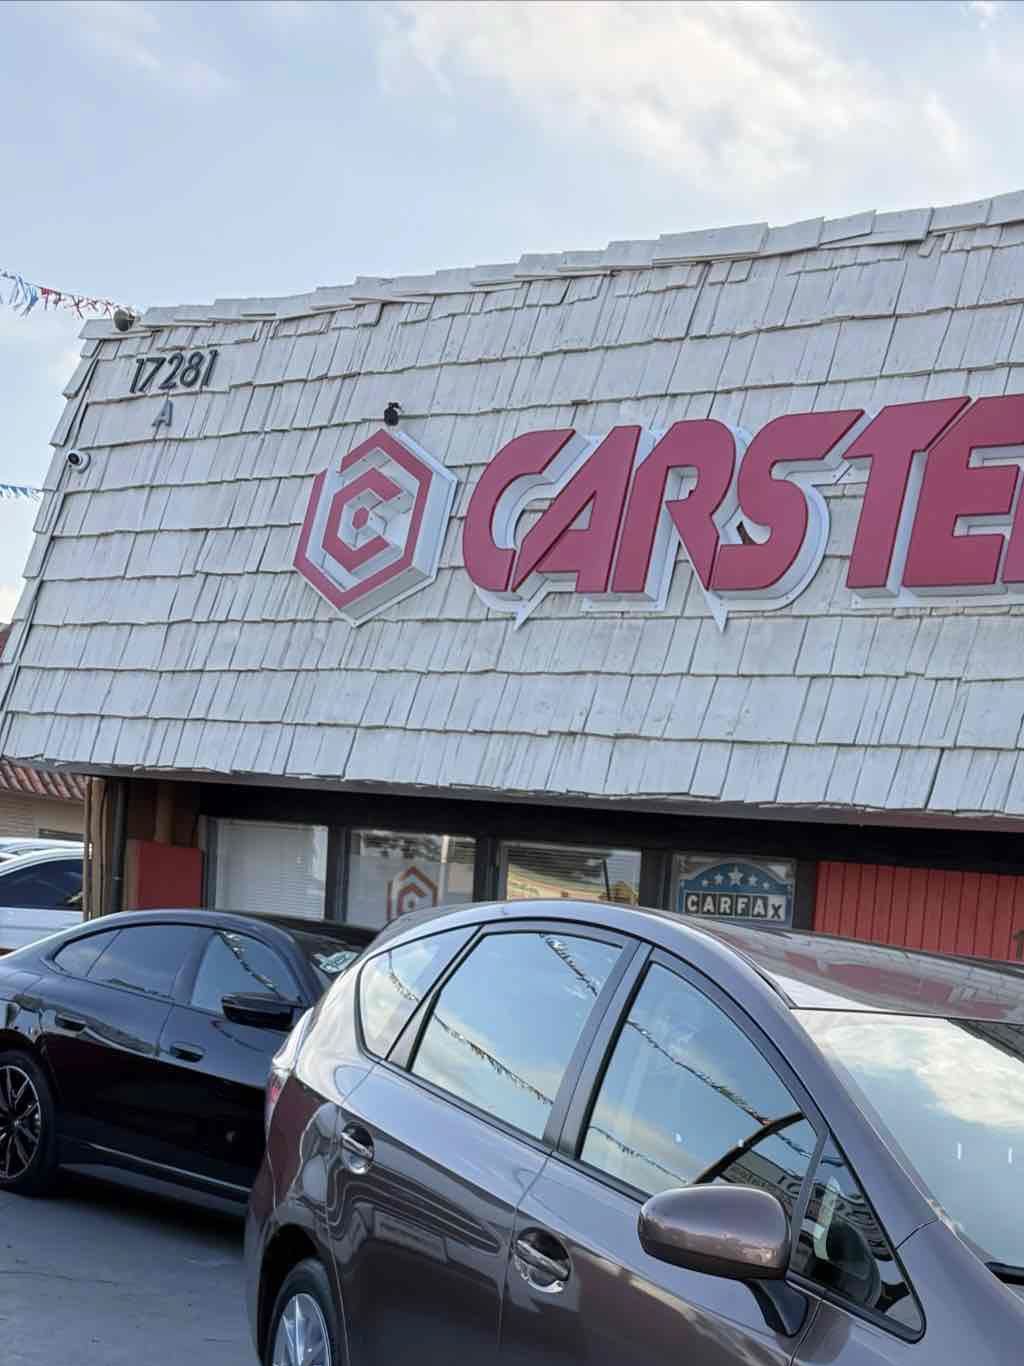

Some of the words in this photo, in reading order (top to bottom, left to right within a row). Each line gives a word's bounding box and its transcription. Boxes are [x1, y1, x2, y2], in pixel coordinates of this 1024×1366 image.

[129, 349, 219, 393] 17281
[151, 399, 174, 428] A
[686, 893, 783, 919] CARFAX
